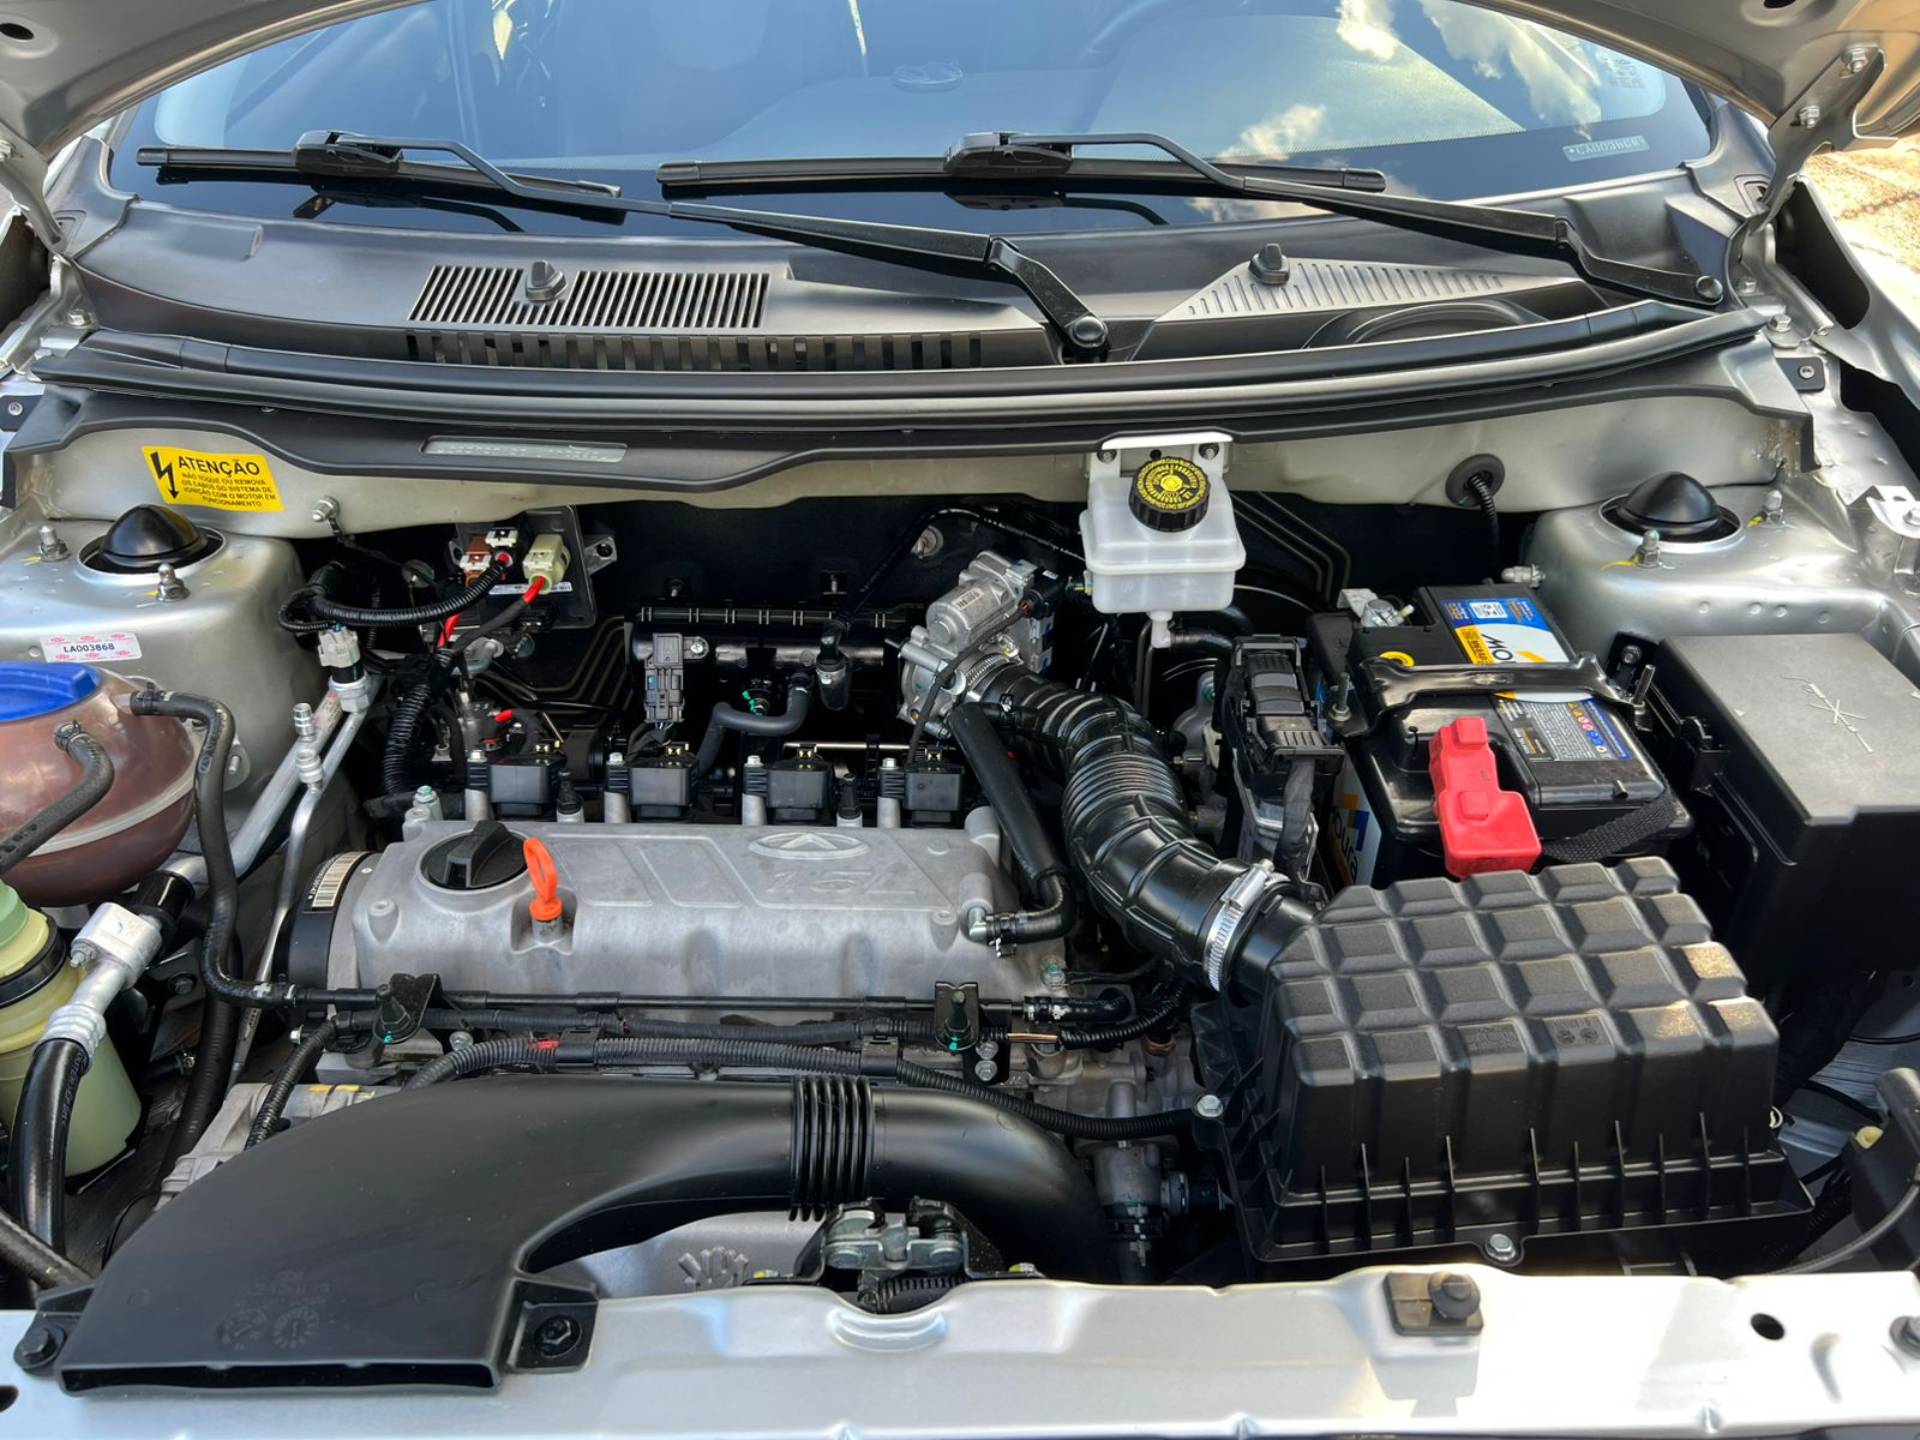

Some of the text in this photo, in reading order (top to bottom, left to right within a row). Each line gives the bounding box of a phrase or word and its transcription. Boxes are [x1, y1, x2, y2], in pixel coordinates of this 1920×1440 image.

[178, 456, 260, 478] ATENÇÃO
[63, 642, 115, 653] LA003868
[1481, 633, 1516, 664] MO
